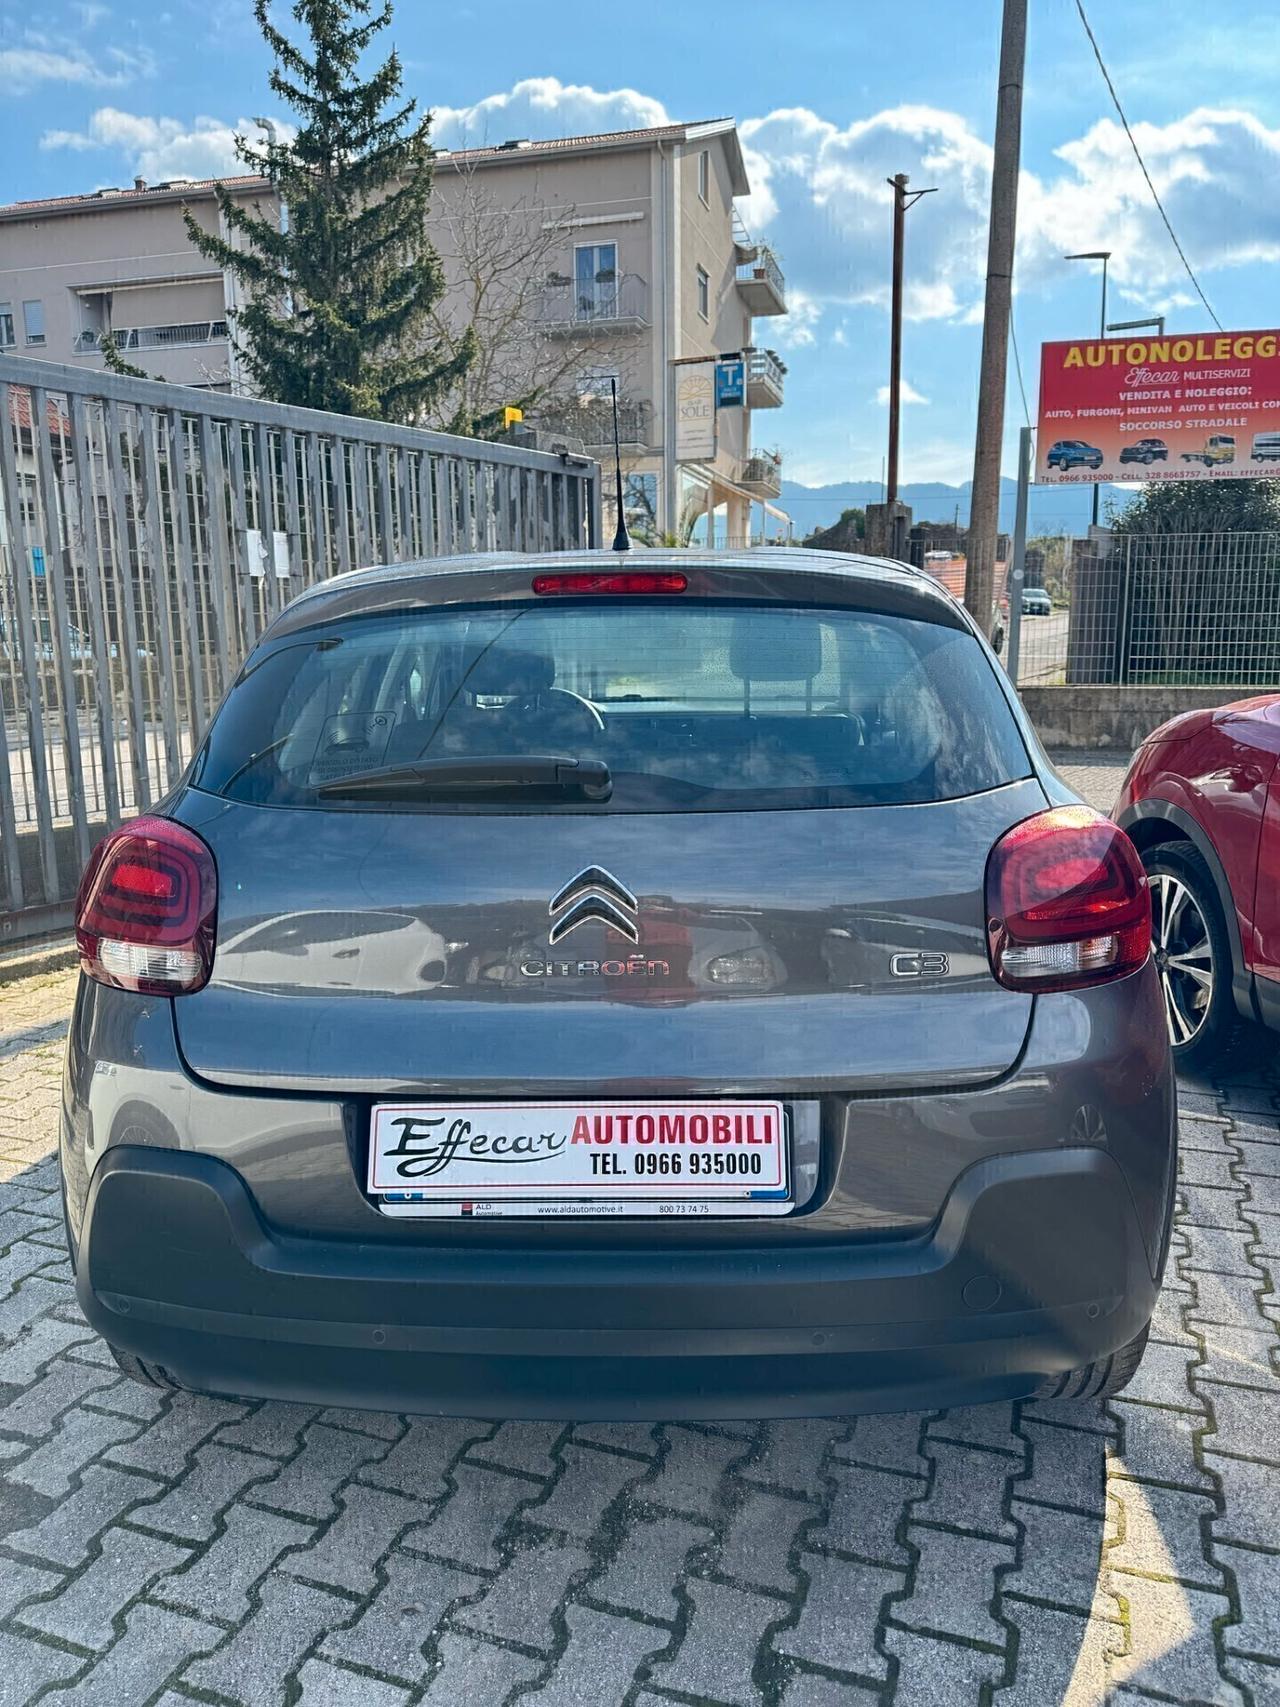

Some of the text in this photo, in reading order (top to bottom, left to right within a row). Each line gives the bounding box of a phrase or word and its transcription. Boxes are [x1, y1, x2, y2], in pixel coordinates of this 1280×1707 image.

[1063, 336, 1280, 367] AUTONOLEGG
[1124, 367, 1251, 387] Effecar MULTISERVIZI
[1119, 386, 1252, 400] VENDITA E NOLEGGIO:
[681, 405, 709, 418] SOLE
[1045, 410, 1074, 419] AUTO,
[1077, 407, 1124, 417] FURGONI,
[1127, 405, 1172, 415] MINIVAN
[1179, 404, 1206, 413] AUTO
[1209, 403, 1215, 411] E
[1218, 401, 1260, 410] VEICOLI
[1120, 417, 1248, 431] SOCCORSO STRADALE
[1059, 474, 1080, 482] 0966
[1082, 473, 1114, 481] 935000
[1209, 470, 1237, 478] EMAIL:
[889, 952, 949, 976] C3
[570, 1115, 772, 1144] AUTOMOBILI
[383, 1117, 567, 1177] Effecar
[590, 1153, 761, 1174] TEL. 0966 935000
[537, 1205, 623, 1214] www.aldautomotive.it
[659, 1205, 709, 1213] 800 73 74 75
